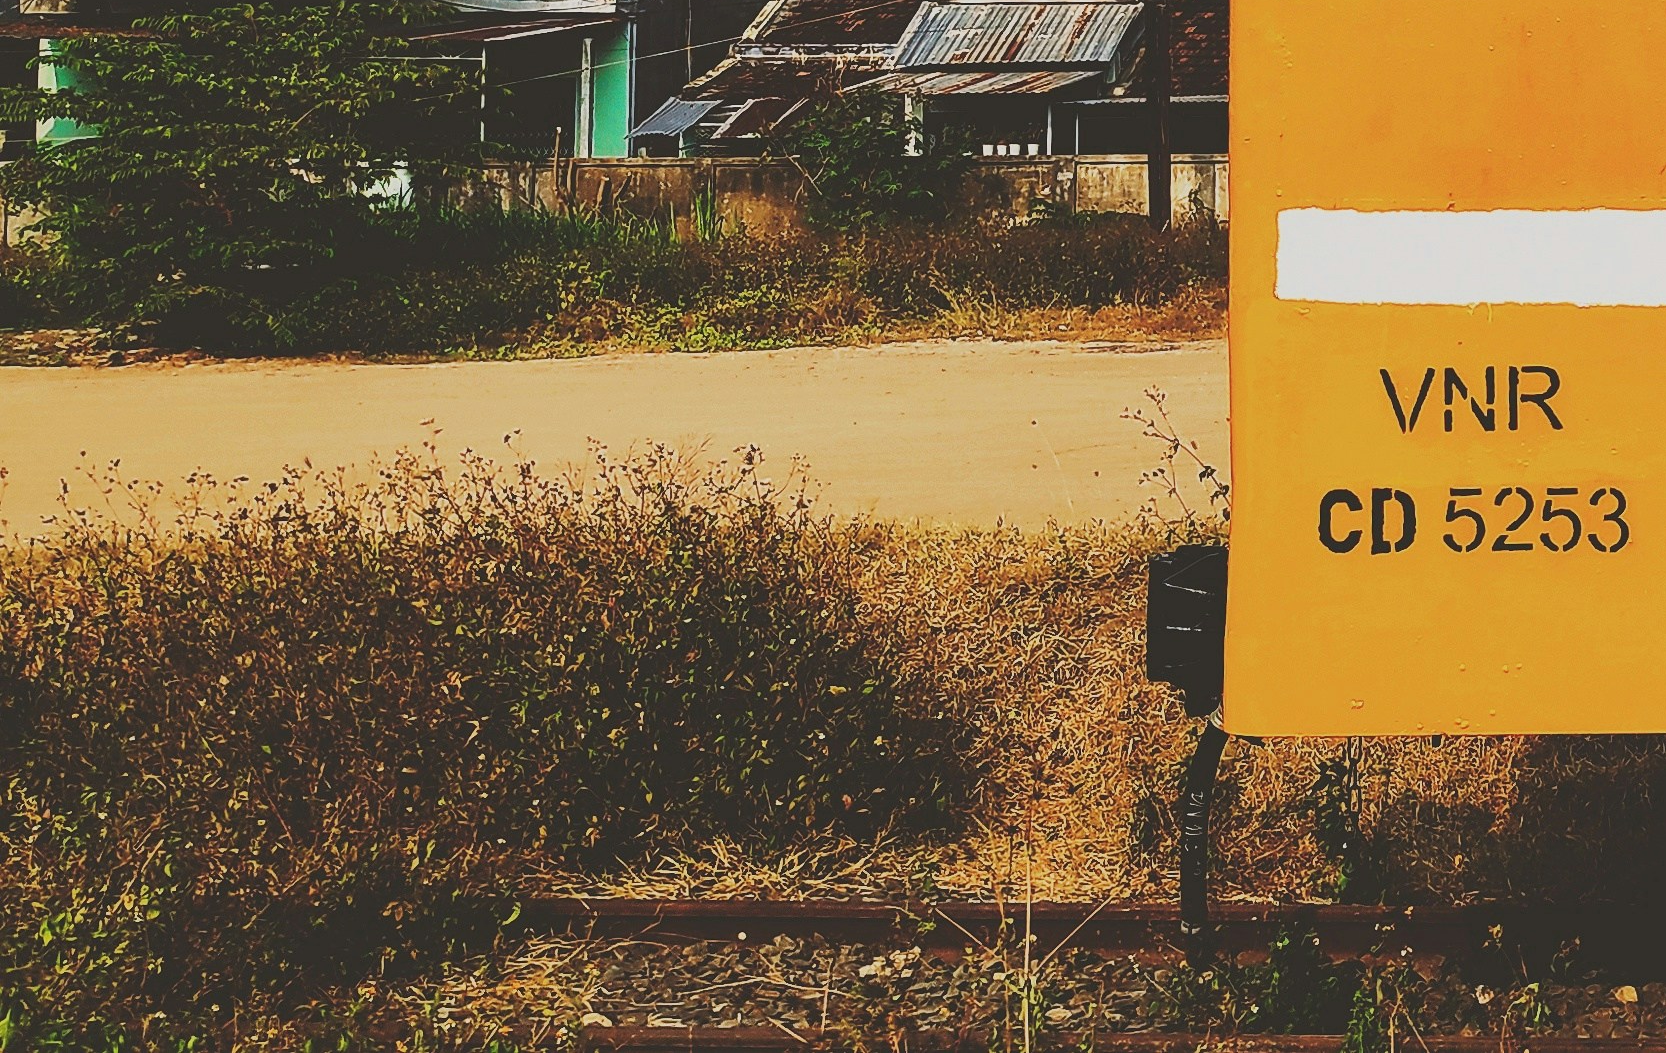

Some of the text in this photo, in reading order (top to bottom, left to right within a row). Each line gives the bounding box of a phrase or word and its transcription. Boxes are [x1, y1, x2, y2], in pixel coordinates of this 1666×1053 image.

[1379, 365, 1564, 434] VNR
[1317, 486, 1630, 556] CD 5253
